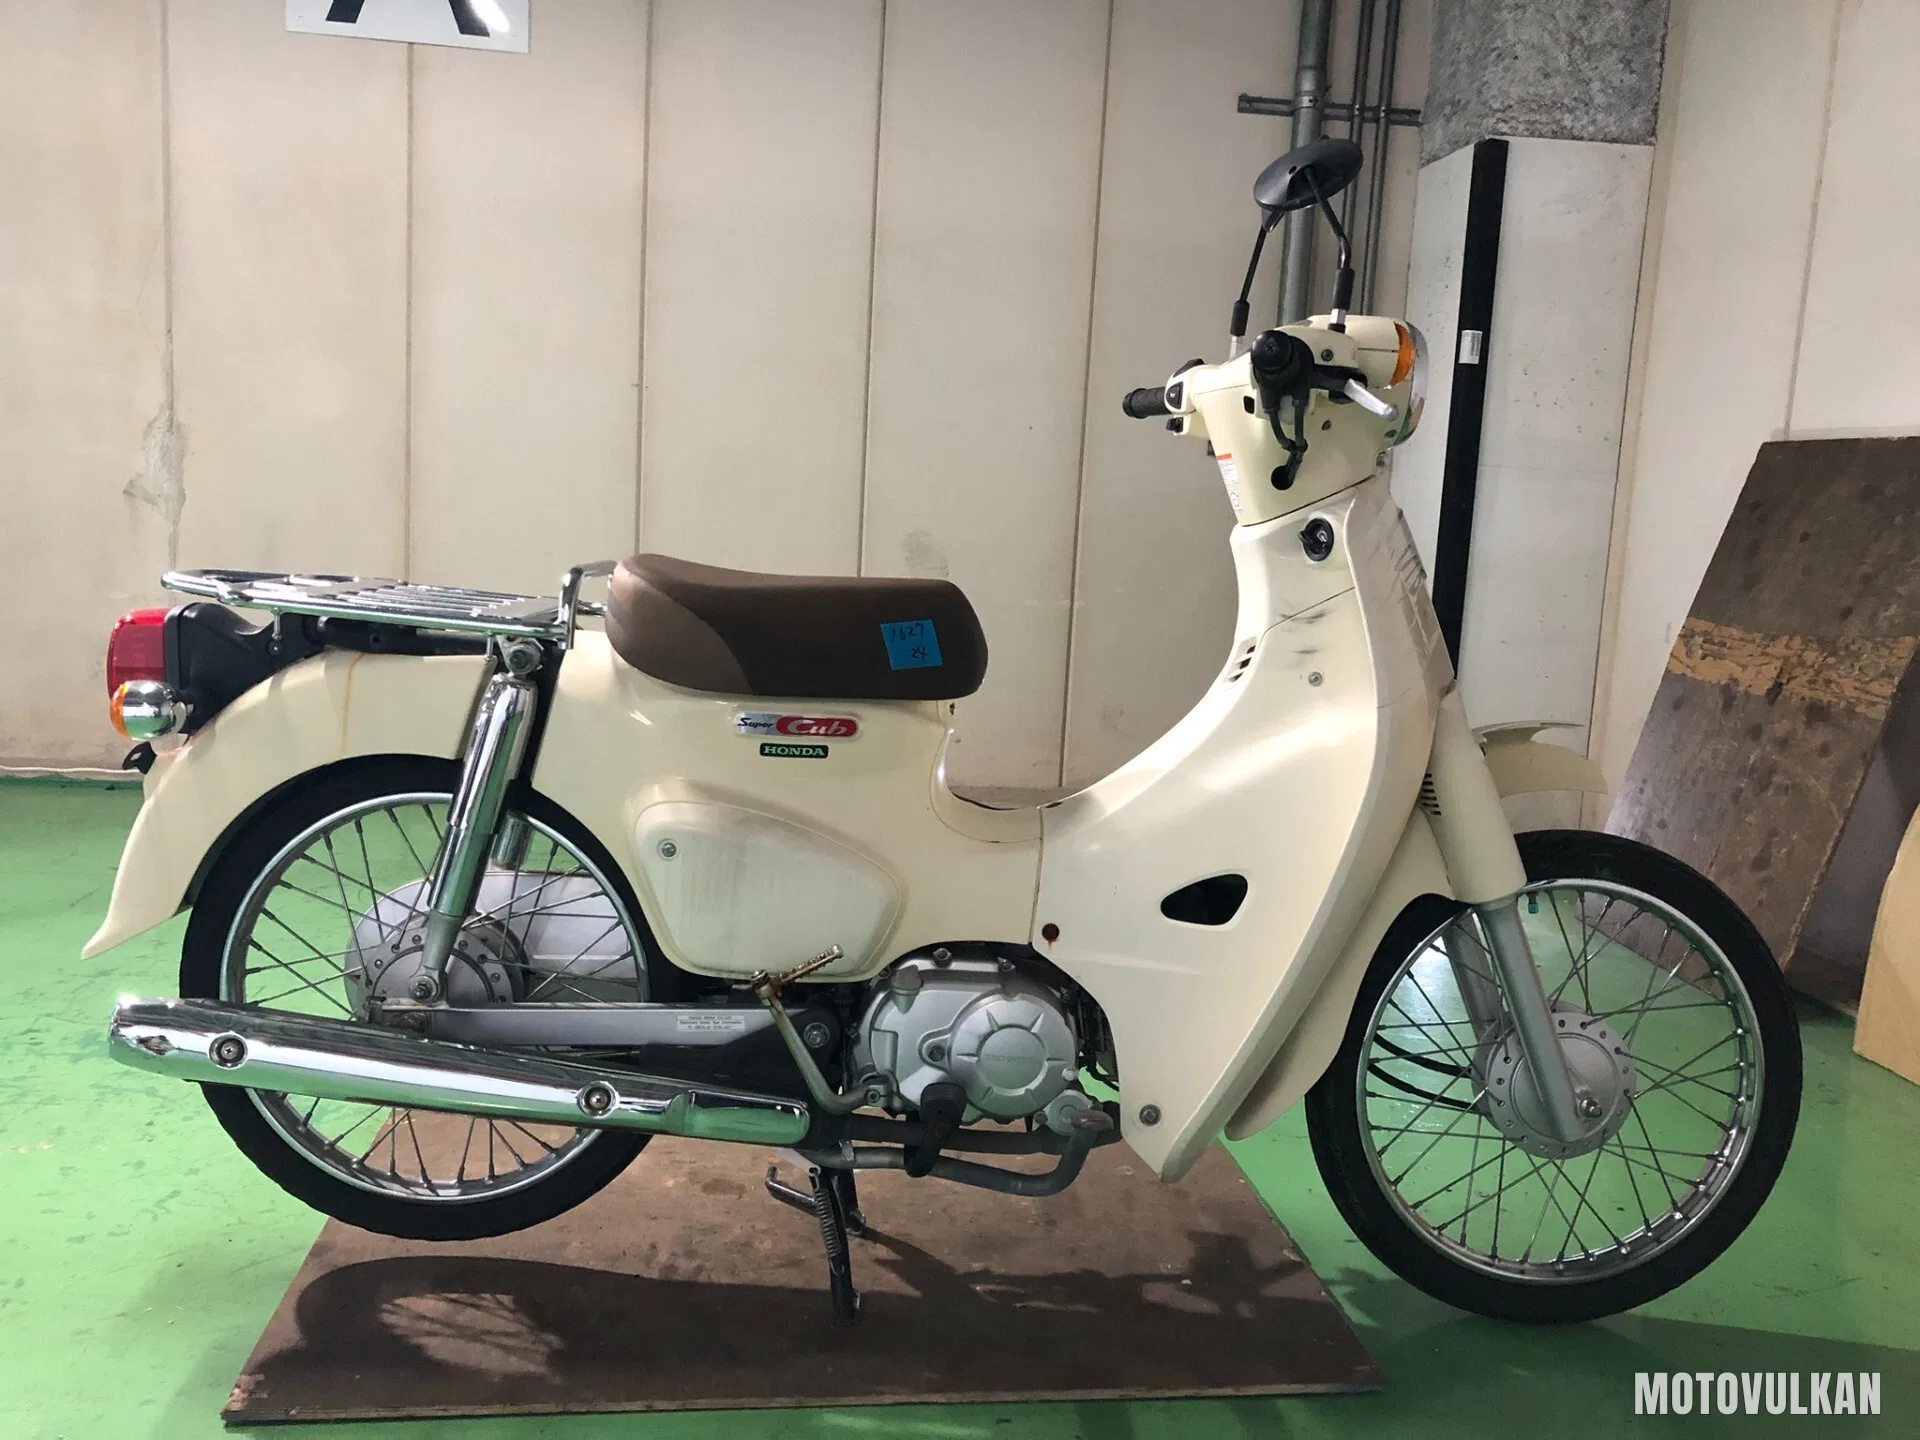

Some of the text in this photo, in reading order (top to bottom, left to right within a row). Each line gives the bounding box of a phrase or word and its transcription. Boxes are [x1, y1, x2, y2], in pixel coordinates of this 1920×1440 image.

[910, 645, 929, 661] 24
[737, 717, 847, 735] Super Cub
[763, 745, 825, 756] HONDA
